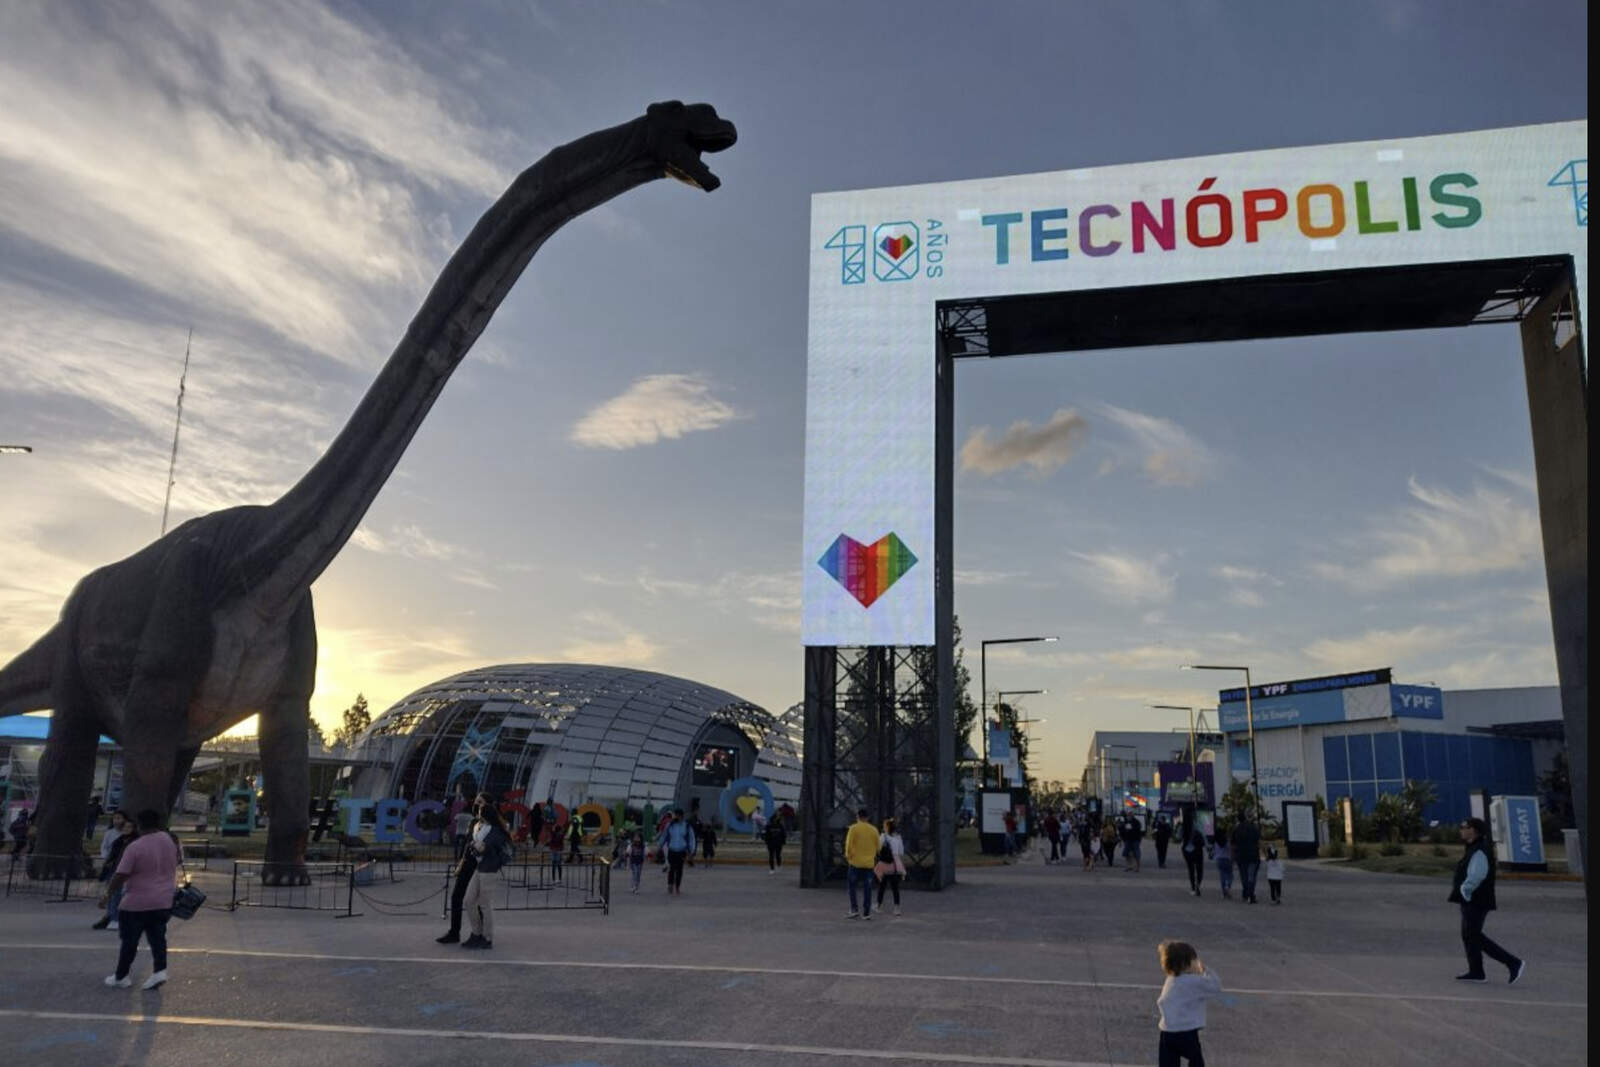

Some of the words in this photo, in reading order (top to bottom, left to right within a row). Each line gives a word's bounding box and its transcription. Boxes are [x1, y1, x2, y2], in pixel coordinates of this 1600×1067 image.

[981, 172, 1482, 265] TECNÓPOLIS
[926, 218, 949, 279] AÑOS
[1263, 683, 1288, 697] YPF
[1400, 693, 1434, 710] YPF
[1257, 766, 1293, 778] SPACIO
[1258, 779, 1305, 798] NERGÍA
[1516, 807, 1533, 856] ARSAT
